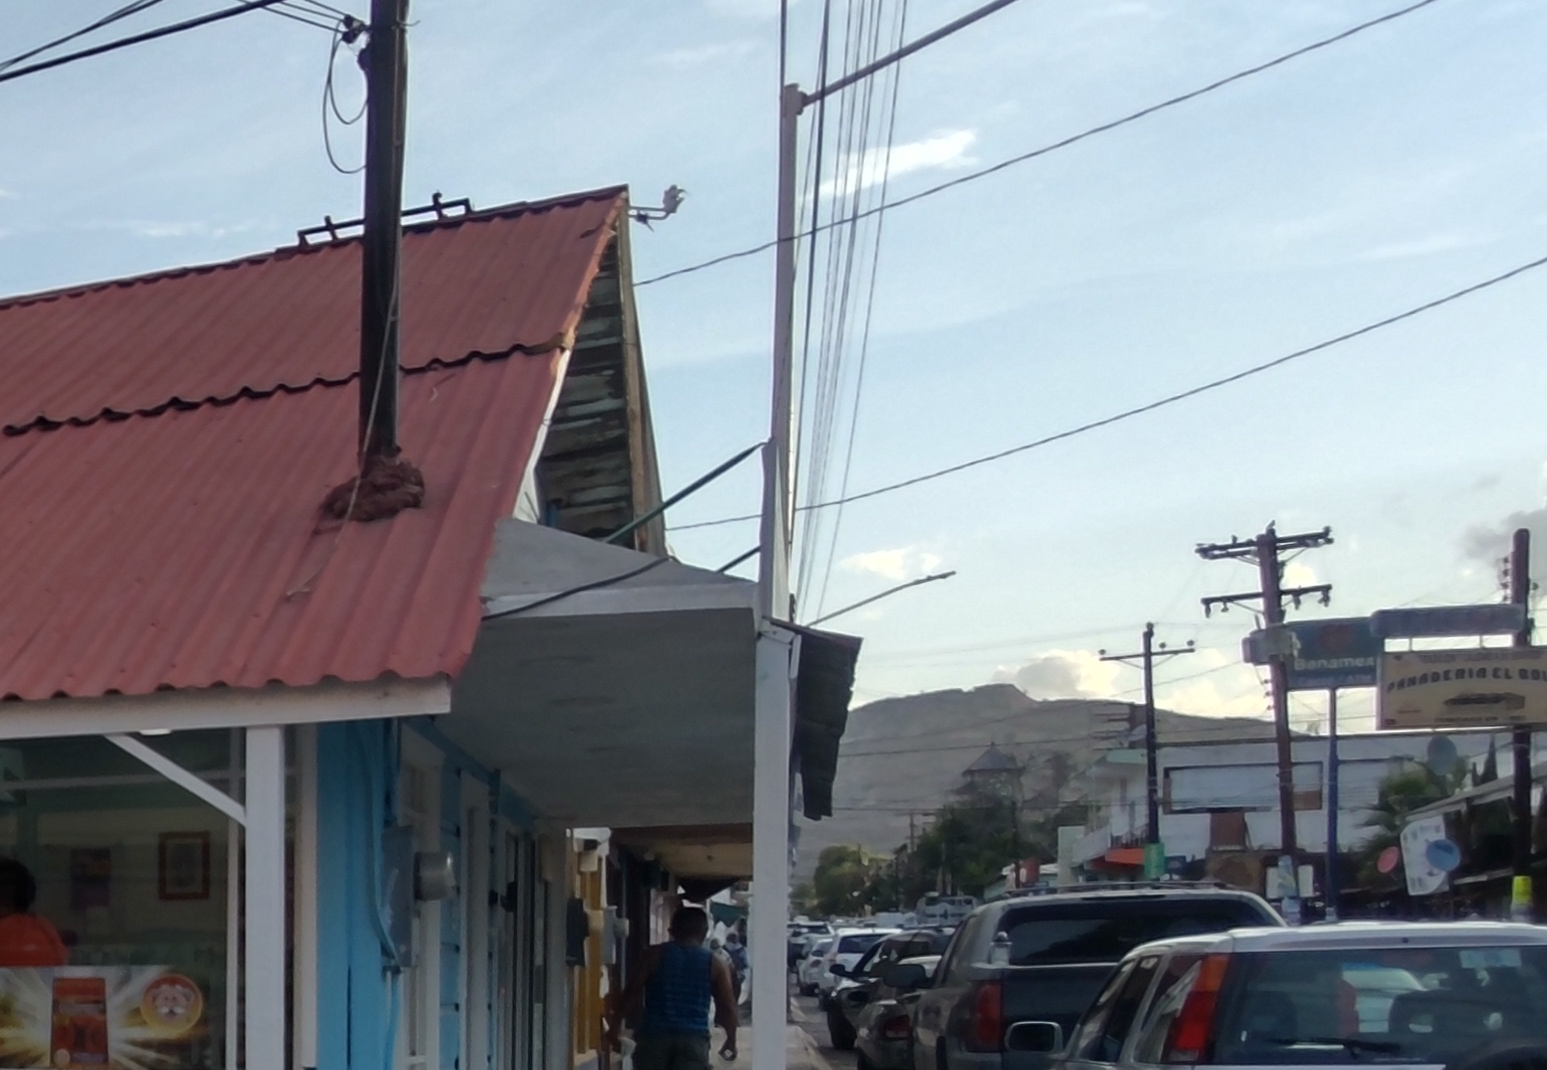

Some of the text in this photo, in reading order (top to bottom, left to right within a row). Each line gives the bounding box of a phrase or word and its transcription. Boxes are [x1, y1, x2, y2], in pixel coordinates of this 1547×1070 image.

[1294, 656, 1375, 671] Banamex
[1386, 667, 1487, 692] PANADERIA
[1492, 667, 1513, 680] EL
